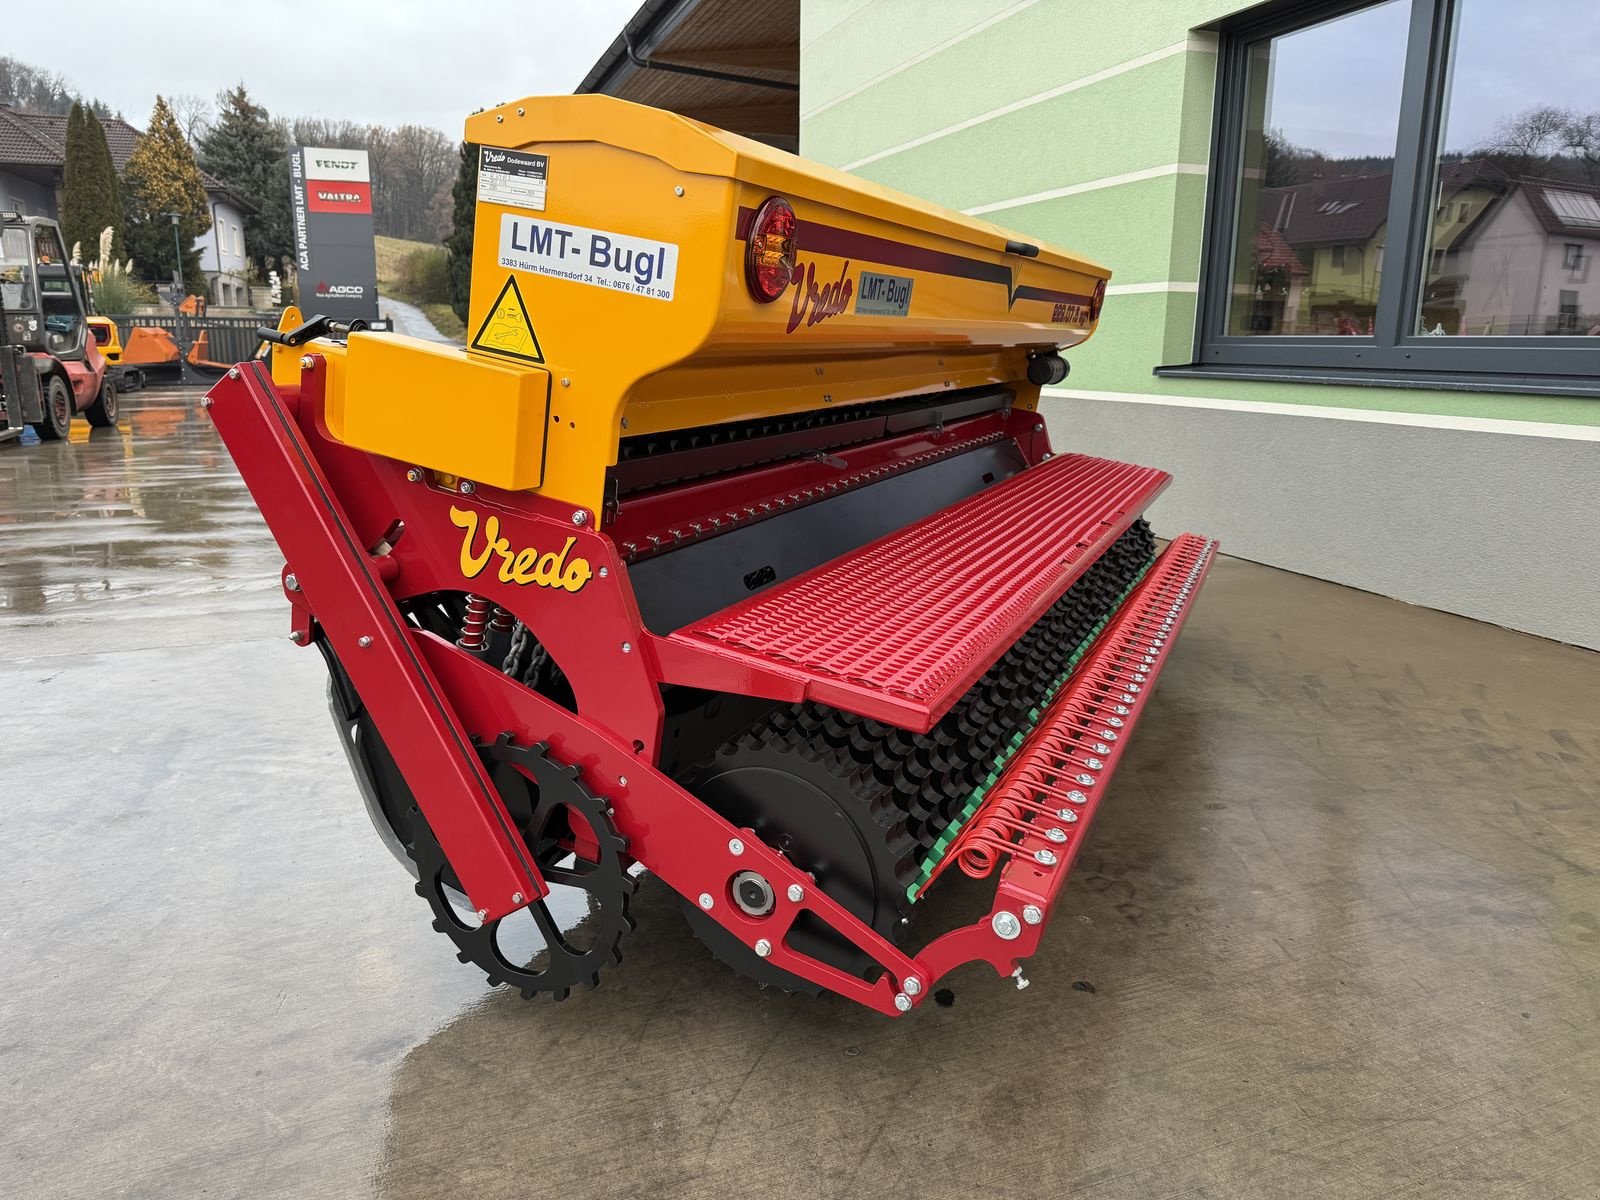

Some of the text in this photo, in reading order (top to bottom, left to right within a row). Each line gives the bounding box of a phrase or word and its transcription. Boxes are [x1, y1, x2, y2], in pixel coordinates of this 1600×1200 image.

[291, 151, 302, 178] BUGL
[315, 159, 359, 170] FENDT
[483, 150, 545, 168] Vredo Dodewaard BV
[295, 185, 304, 205] LMT
[317, 191, 362, 203] VALTRA
[296, 206, 307, 250] PARTNER
[300, 250, 310, 271] ACA
[589, 234, 665, 285] Bugl
[329, 285, 364, 294] AGCO
[501, 257, 518, 268] 3383
[519, 260, 538, 272] Hürm
[539, 264, 583, 281] Harmersdorf
[583, 274, 593, 283] 34
[596, 276, 612, 287] Tel.:
[613, 280, 630, 291] 0676
[635, 285, 645, 294] 47
[646, 287, 655, 296] 81
[656, 289, 671, 299] 300
[786, 260, 853, 335] Vredo
[886, 279, 911, 309] Bugl
[449, 504, 593, 593] Vredo
